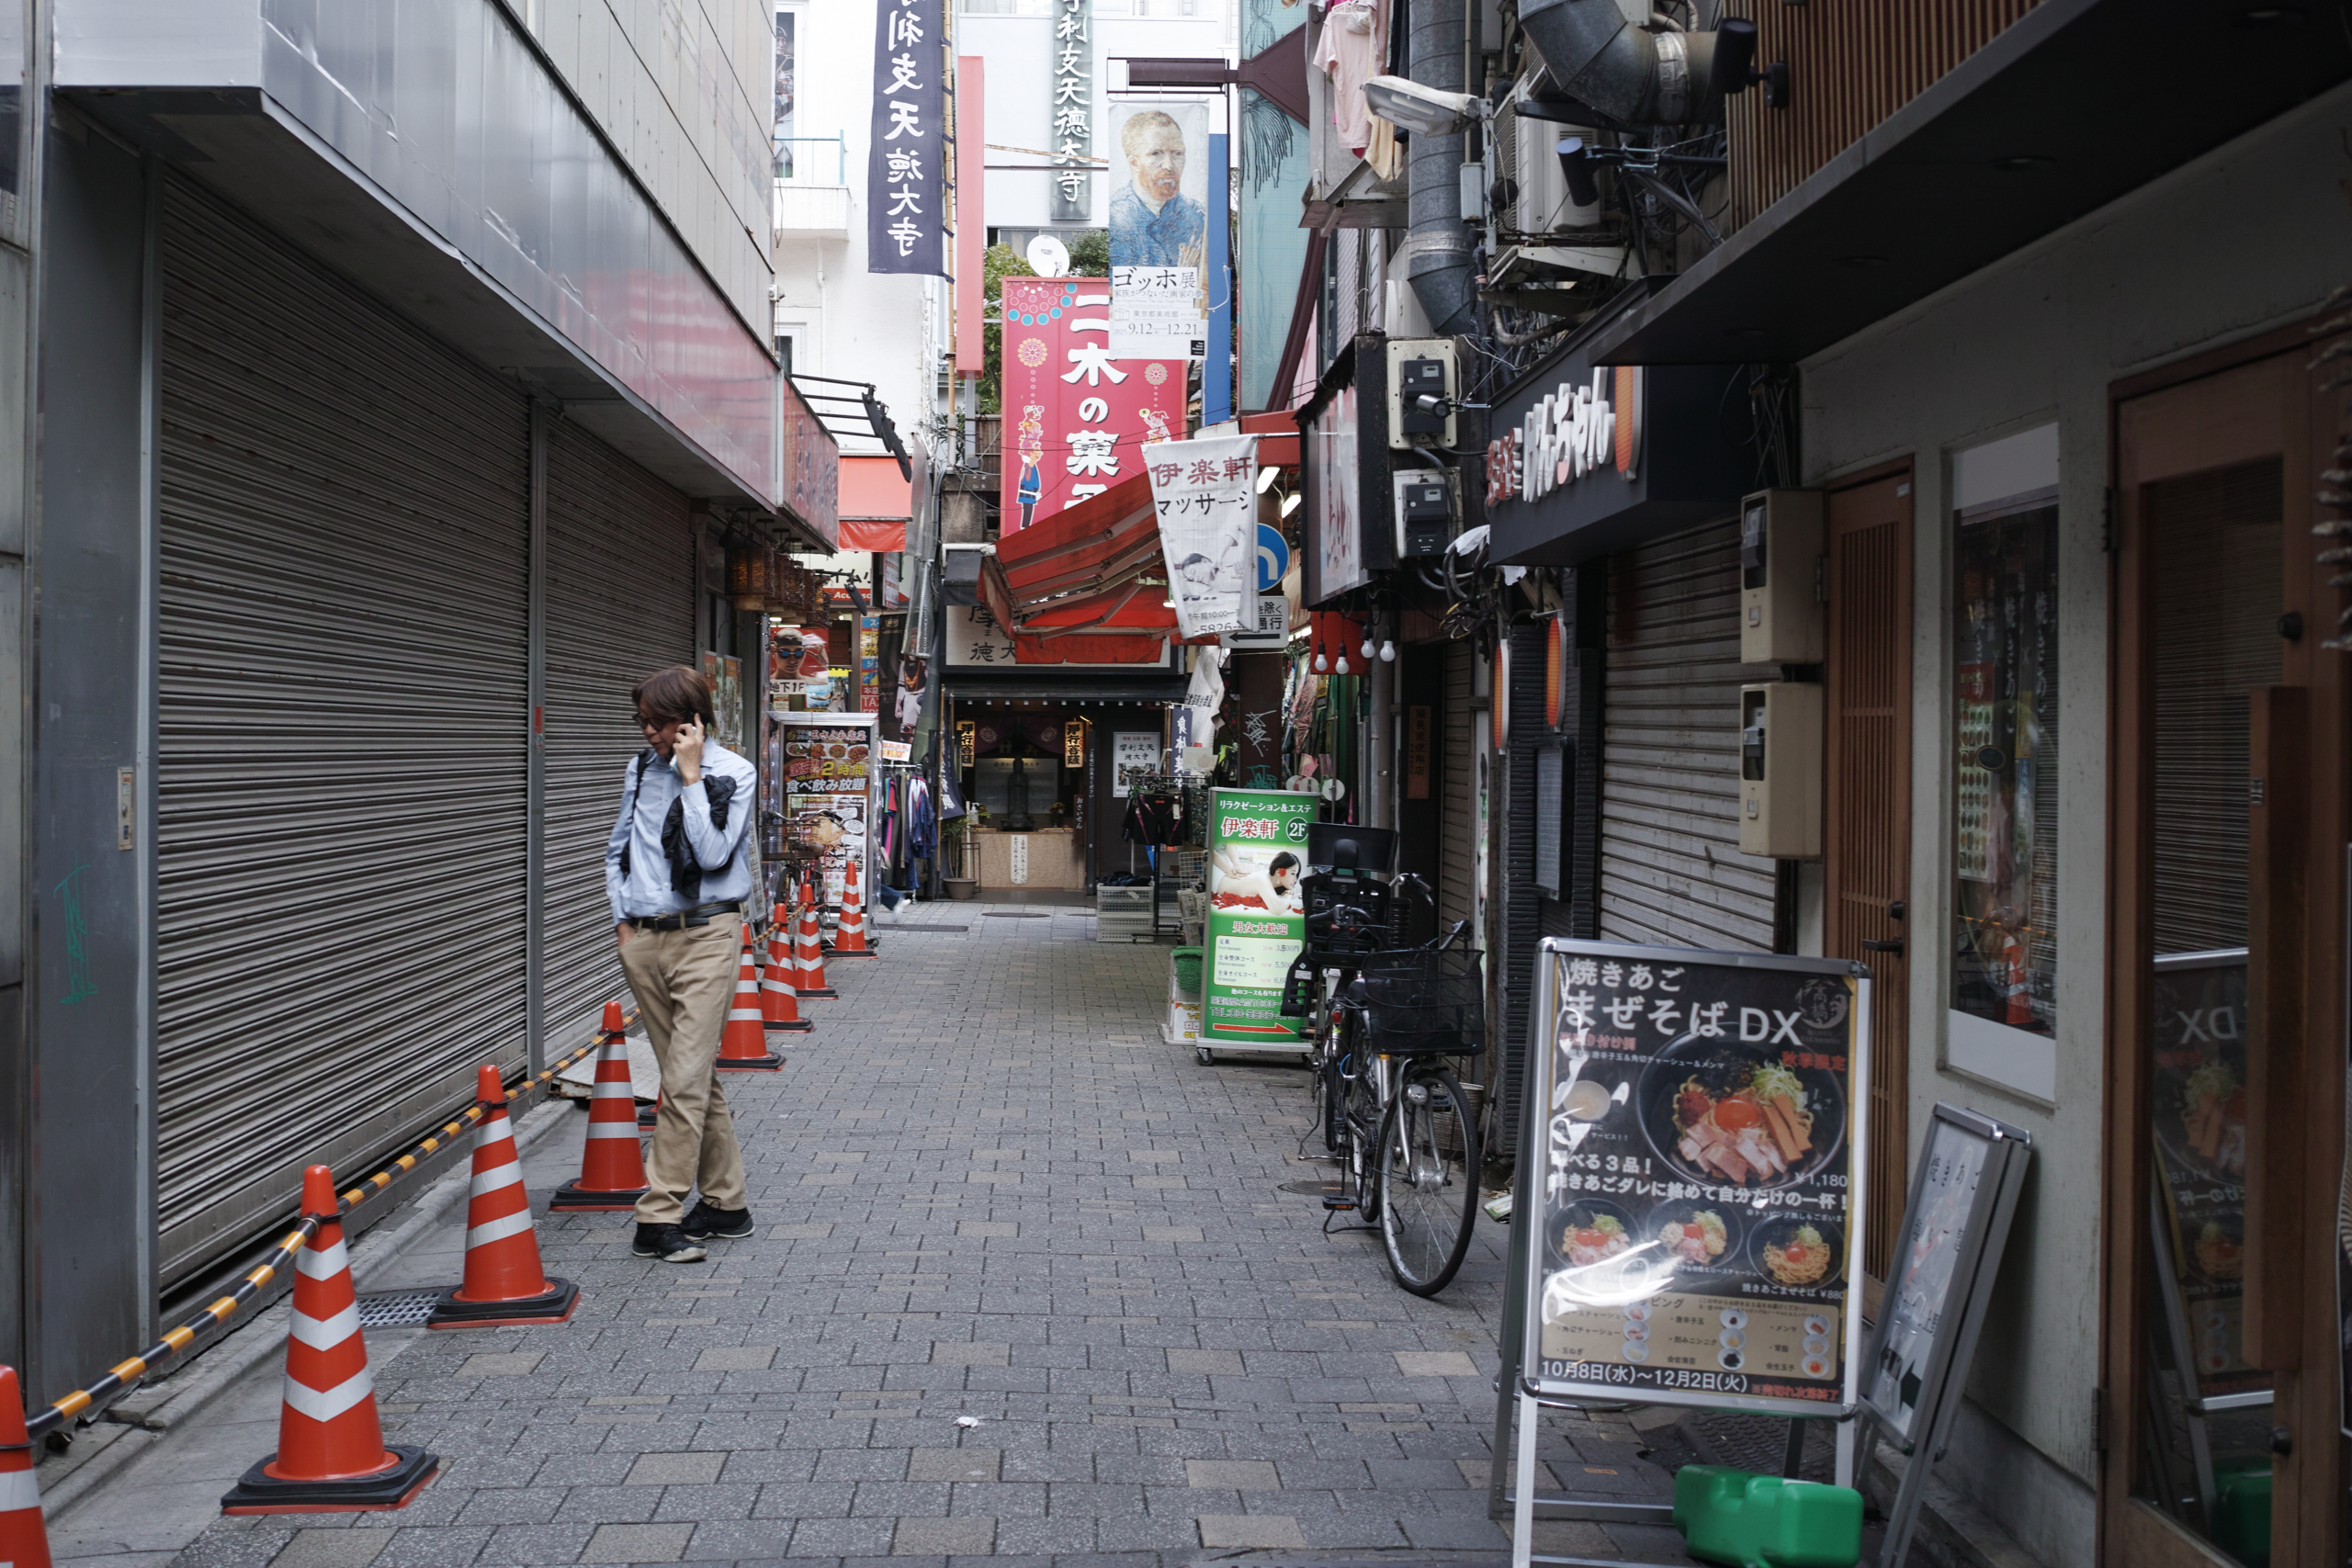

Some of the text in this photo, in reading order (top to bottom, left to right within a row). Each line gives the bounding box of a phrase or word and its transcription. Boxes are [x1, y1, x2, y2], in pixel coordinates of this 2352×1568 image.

[1114, 266, 1196, 292] ゴッホ展
[1114, 289, 1203, 299] 家族がつないだ画家の夢
[1149, 456, 1252, 488] 伊楽軒
[770, 680, 806, 693] 地下1F
[821, 761, 865, 776] 2時間
[786, 778, 866, 794] 食べ飲み放題
[1219, 799, 1312, 813] リラクゼーション&エステ
[1221, 816, 1279, 840] 伊楽軒
[1288, 822, 1306, 837] 2F
[1232, 920, 1289, 936] 男女大歓迎
[1218, 953, 1255, 962] 全身整体コース
[1217, 969, 1258, 977] 全身オイルコース
[1568, 958, 1687, 992] 焼きあご
[1231, 987, 1283, 997] 他のコースも有ります
[1565, 989, 1804, 1045] まぜそば DX
[1794, 1171, 1849, 1187] ¥1,180
[1742, 1282, 1816, 1298] 焼きあごまぜそば
[1775, 1325, 1798, 1333] メンマ
[1674, 1336, 1717, 1347] 刻みニンニク
[1561, 1347, 1584, 1356] 玉ねぎ
